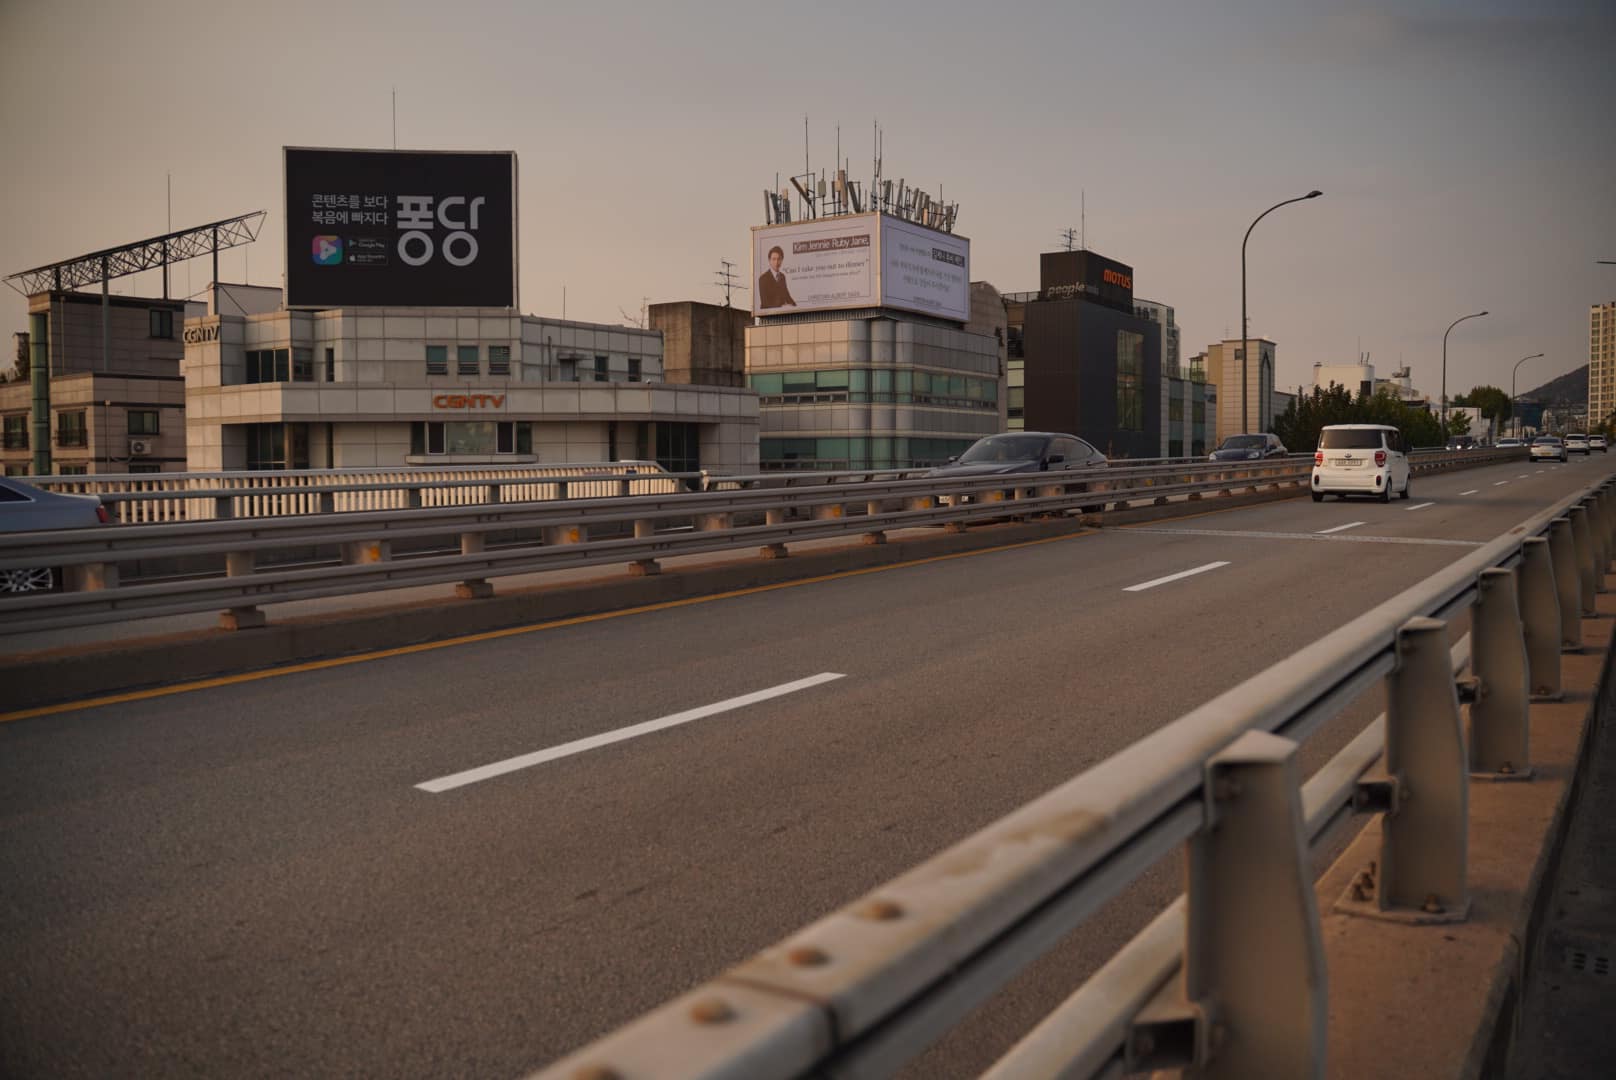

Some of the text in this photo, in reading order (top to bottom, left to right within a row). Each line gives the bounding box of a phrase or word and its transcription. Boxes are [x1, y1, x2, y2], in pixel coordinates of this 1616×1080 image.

[312, 194, 389, 209] 콘텐츠를 보다
[312, 210, 389, 225] 복음에 빠지다
[397, 195, 485, 266] 퐁당
[809, 240, 830, 250] Jennie
[832, 238, 849, 249] Ruby
[182, 325, 220, 344] CGNTV
[433, 394, 505, 409] CGNTV
